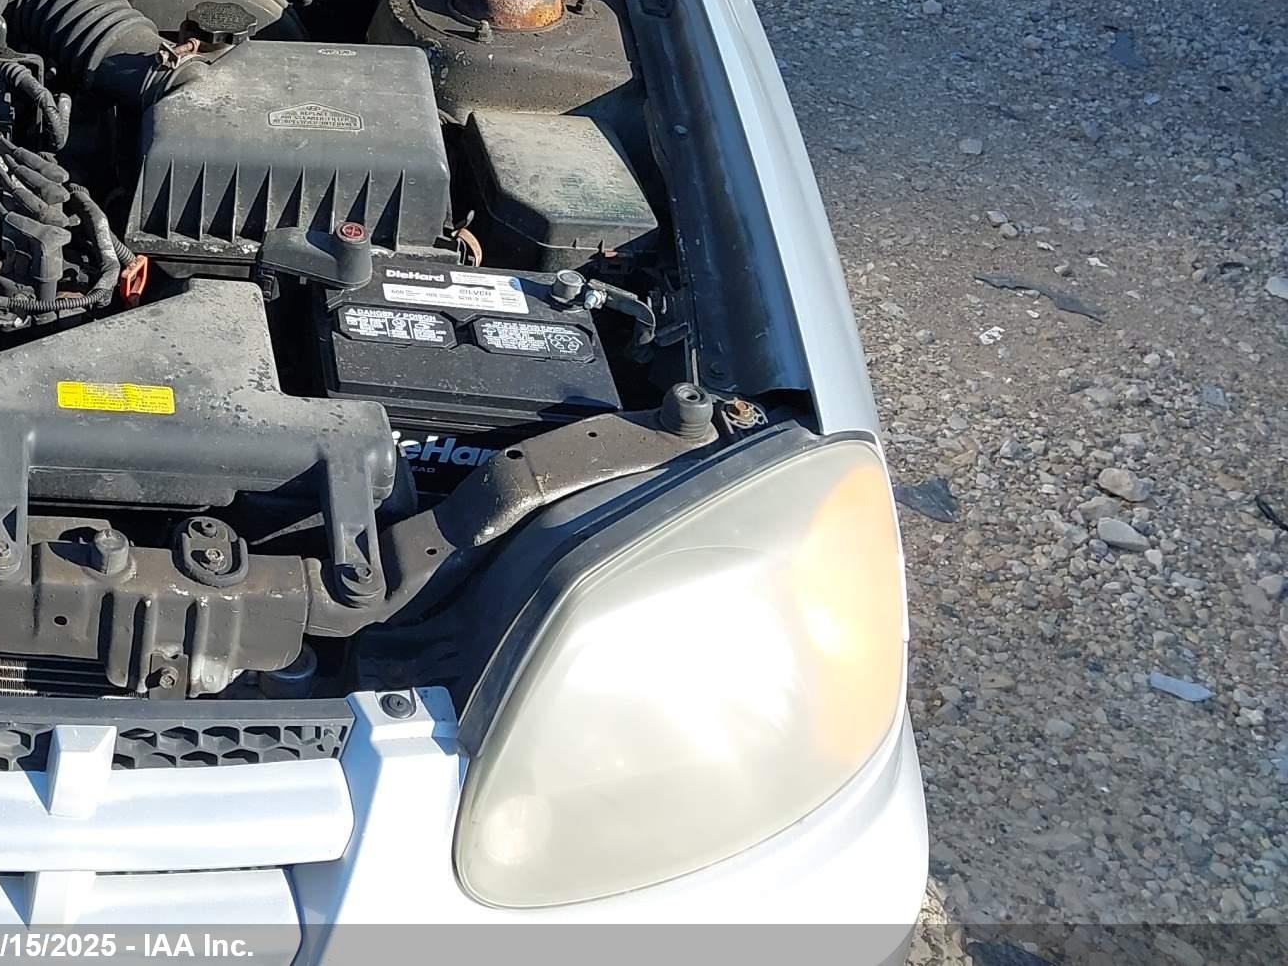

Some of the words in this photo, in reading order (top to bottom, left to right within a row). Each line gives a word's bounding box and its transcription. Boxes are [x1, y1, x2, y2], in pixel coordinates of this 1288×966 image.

[385, 269, 445, 282] DieHard
[356, 308, 394, 318] DANGER
[403, 312, 437, 321] POISON
[392, 430, 502, 467] ieHar
[412, 465, 436, 473] EAD
